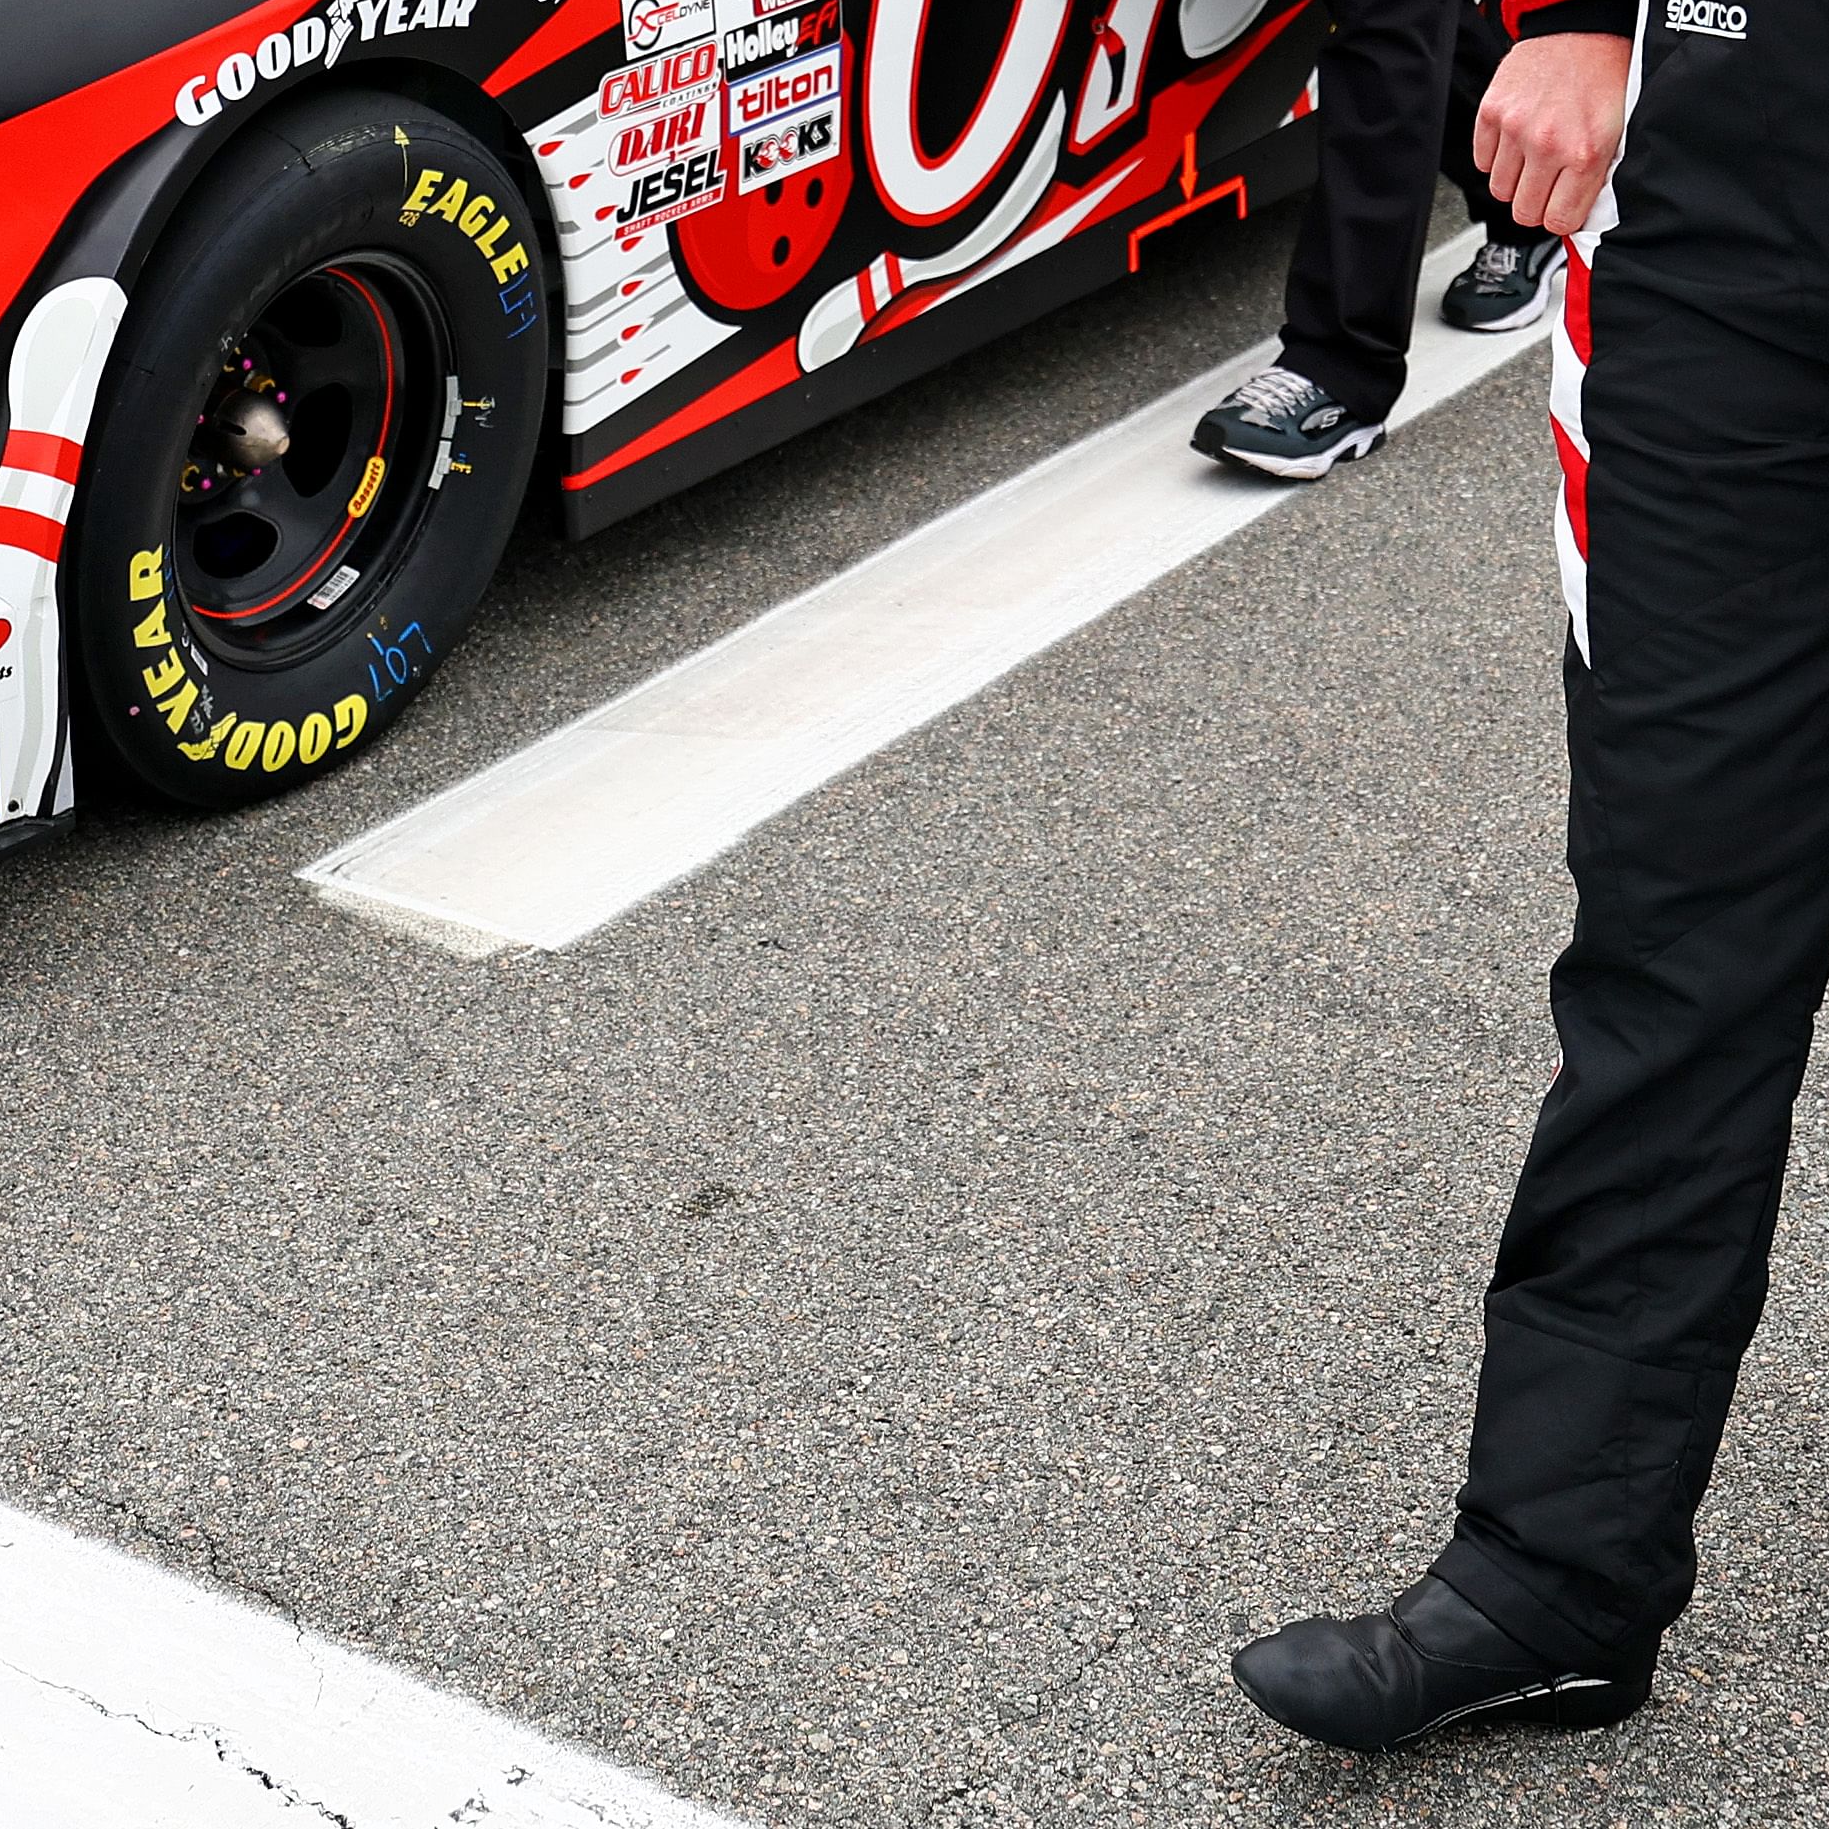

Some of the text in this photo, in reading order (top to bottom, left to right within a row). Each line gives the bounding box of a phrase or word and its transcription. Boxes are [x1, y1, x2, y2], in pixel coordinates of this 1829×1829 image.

[725, 17, 800, 70] Holley
[599, 42, 718, 118] CALICO
[662, 82, 720, 109] COATINGS
[737, 64, 833, 122] tilton
[616, 94, 715, 168] DART
[742, 113, 833, 183] KOOKS
[616, 149, 728, 224] JESEL
[623, 192, 715, 236] SHAFT ROCKER ARMS
[402, 168, 530, 285] EAGLE
